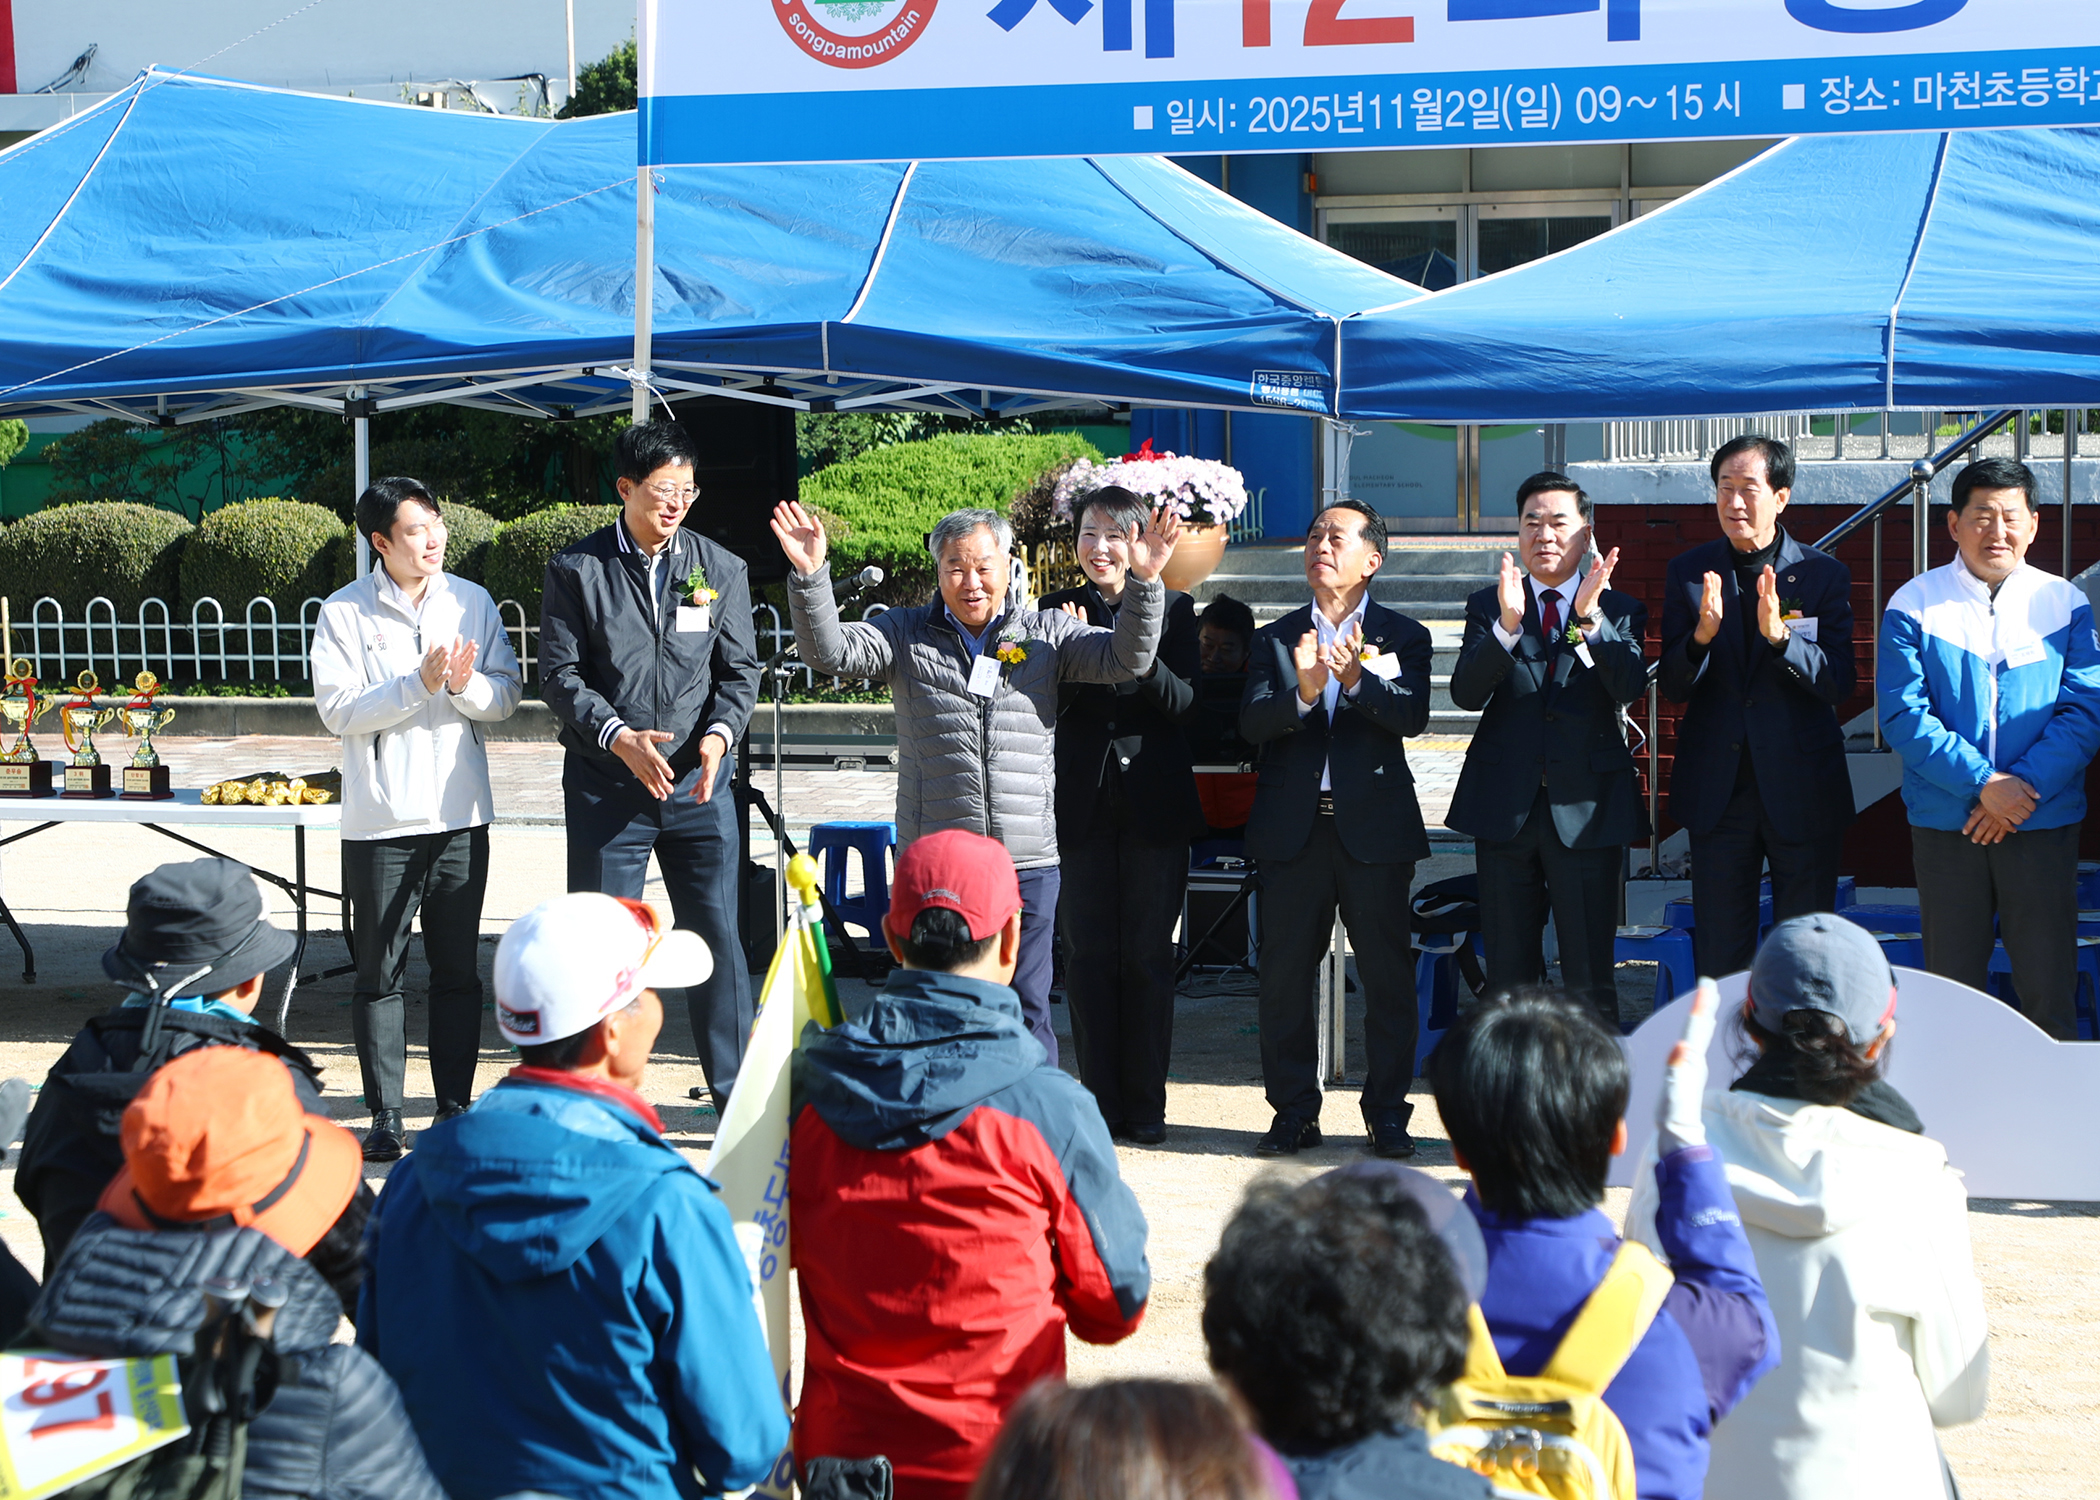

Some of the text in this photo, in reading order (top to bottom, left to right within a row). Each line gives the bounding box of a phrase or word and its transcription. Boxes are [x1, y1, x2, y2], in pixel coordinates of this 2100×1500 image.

[788, 9, 921, 59] songpamountain
[1167, 97, 1236, 134] 일시:
[1248, 83, 1562, 132] 2025년11월2일(일)
[1783, 75, 1900, 115] 장소:
